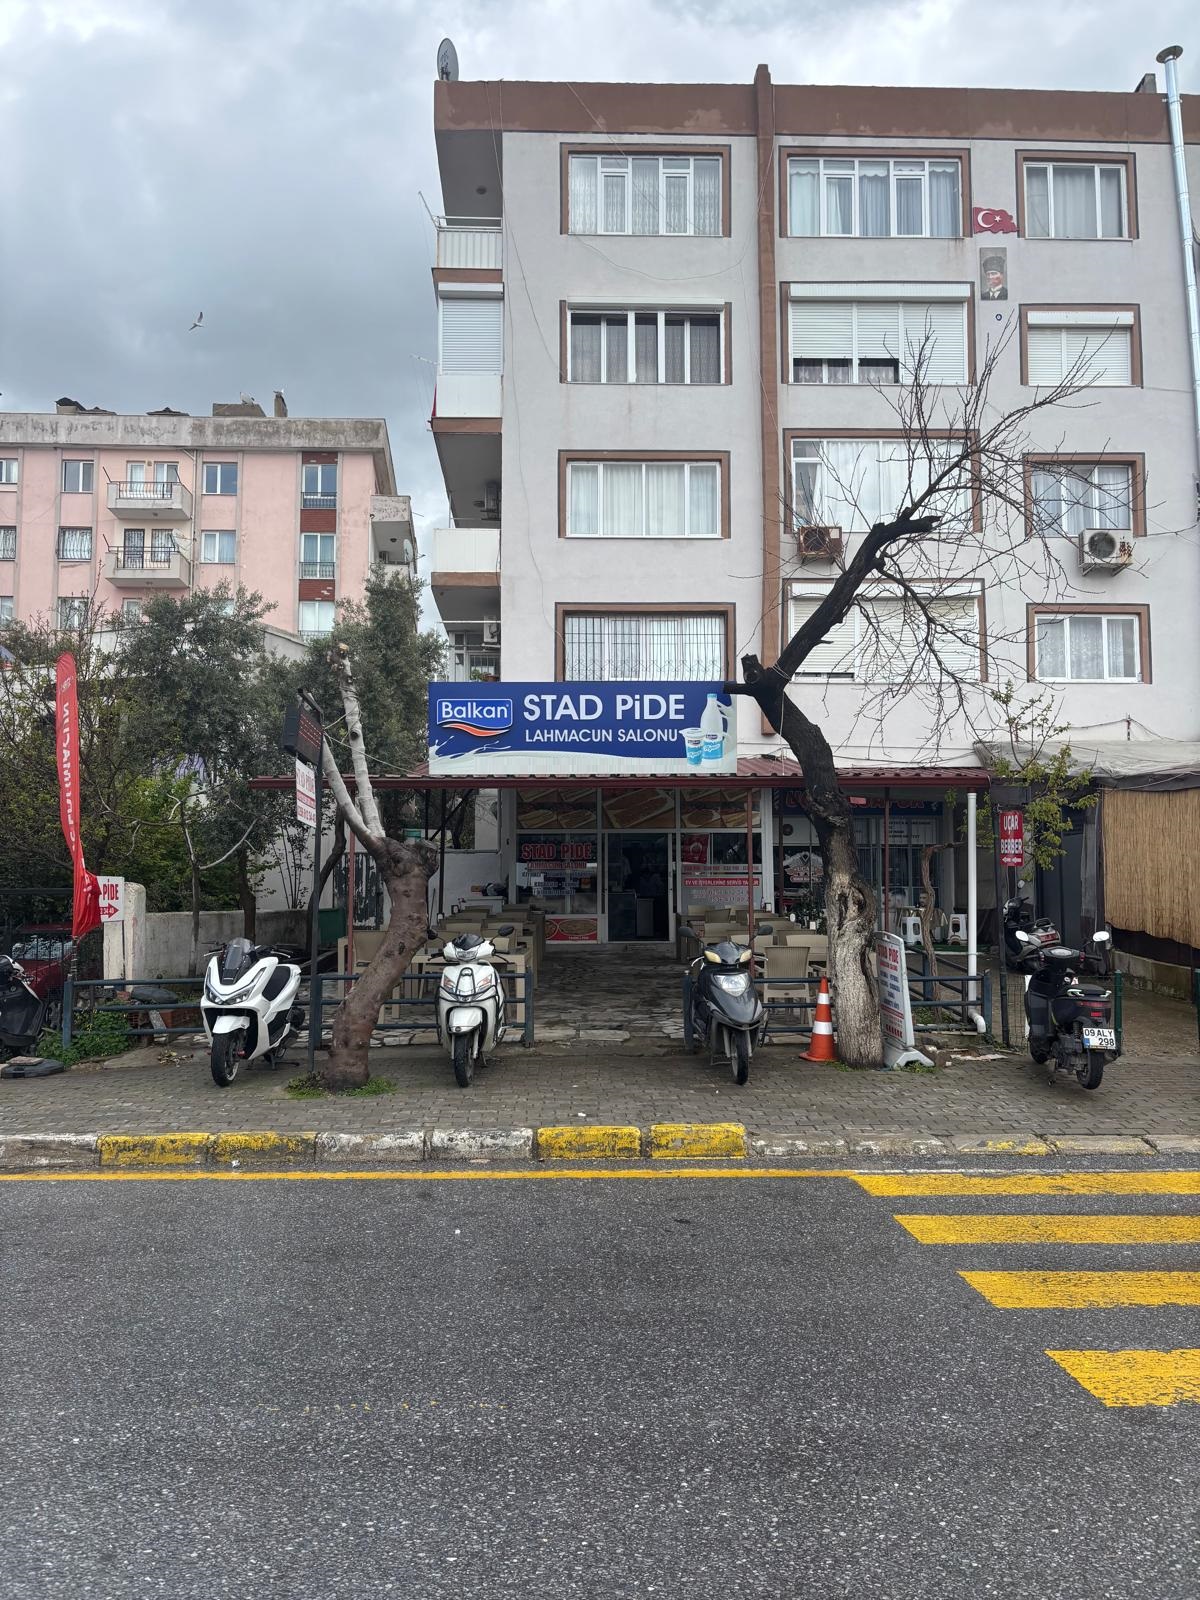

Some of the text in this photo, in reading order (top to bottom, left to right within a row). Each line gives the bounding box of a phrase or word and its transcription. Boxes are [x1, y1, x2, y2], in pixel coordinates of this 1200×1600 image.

[441, 701, 508, 719] Balkan
[523, 694, 603, 721] STAD
[525, 728, 678, 742] LAHMACUN SALONU
[1003, 815, 1019, 835] UÇAR
[521, 843, 556, 860] STAD
[1000, 839, 1022, 854] BERBER
[102, 879, 119, 901] PİDE
[1084, 1029, 1113, 1038] 09 ALY
[1098, 1037, 1115, 1047] 298
